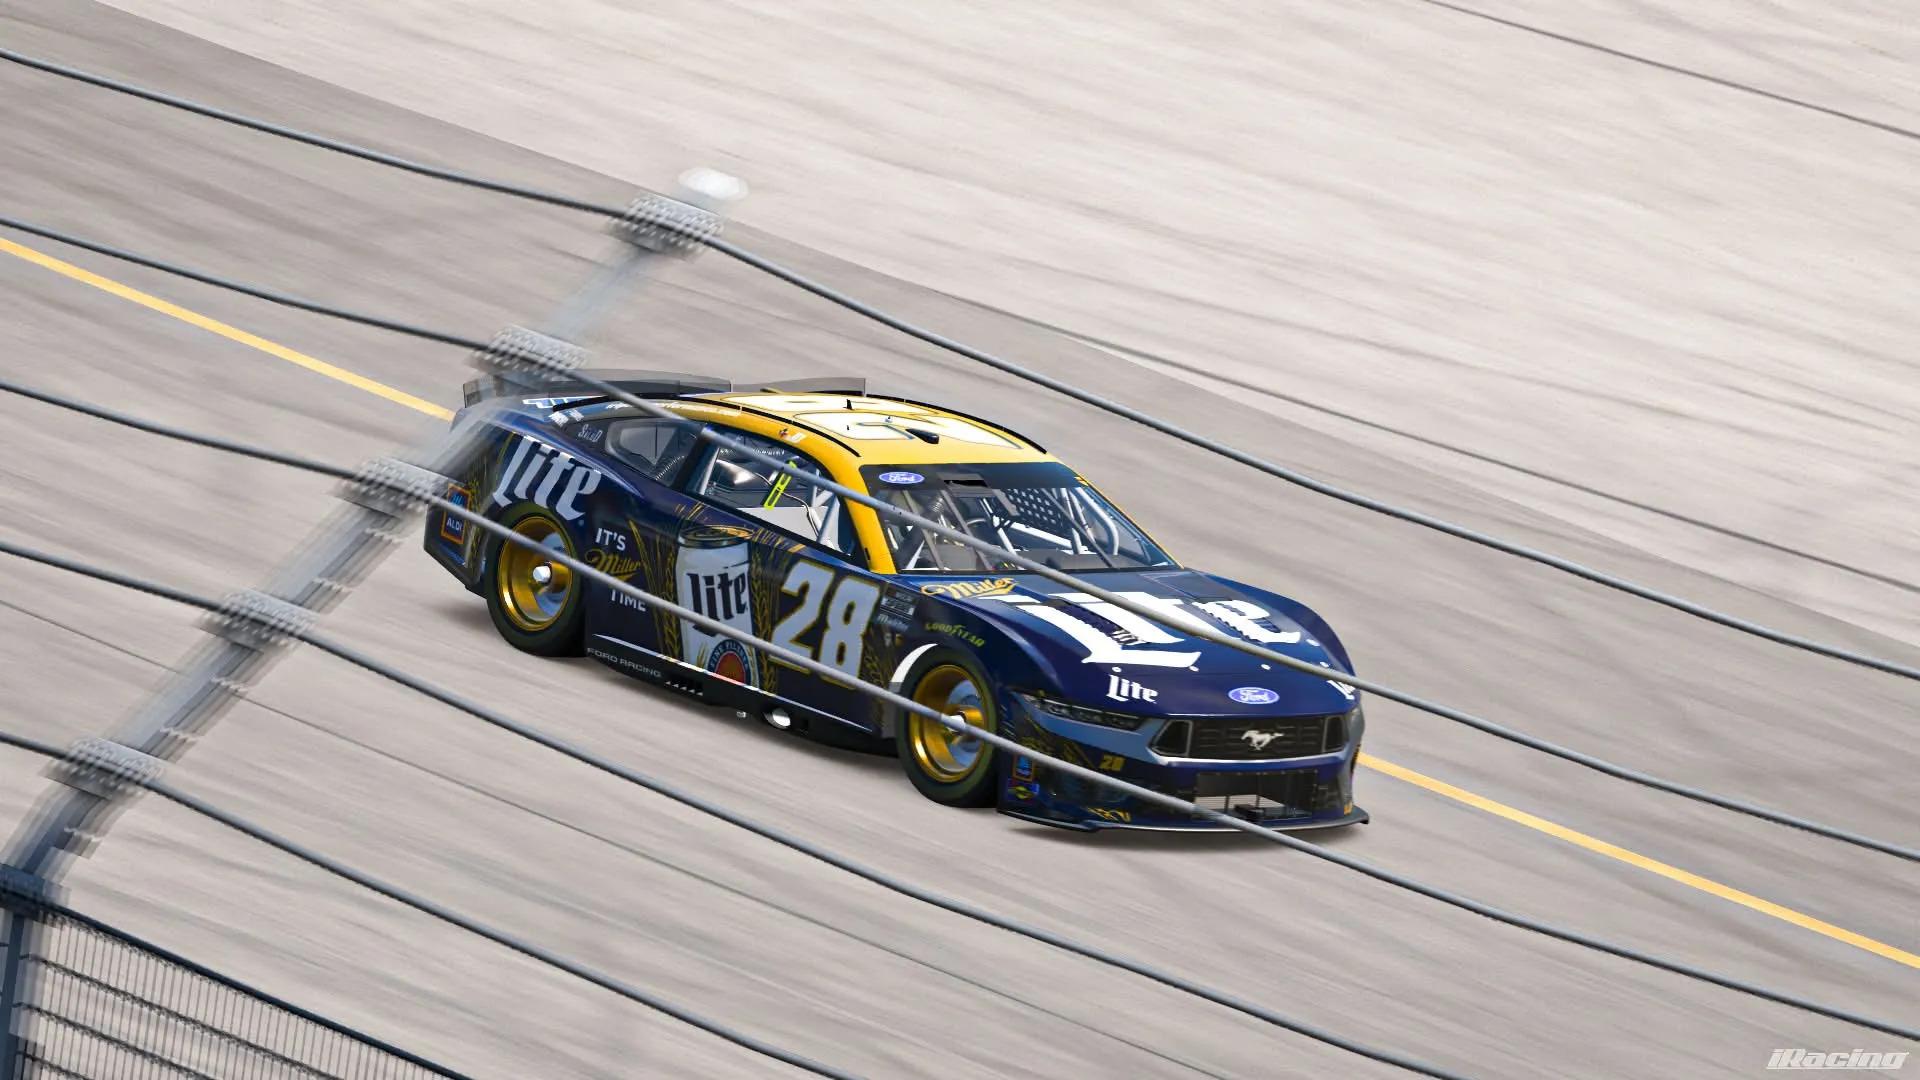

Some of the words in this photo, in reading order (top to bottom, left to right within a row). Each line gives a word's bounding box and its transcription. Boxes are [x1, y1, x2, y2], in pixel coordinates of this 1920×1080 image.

[595, 527, 627, 551] IT'S
[585, 549, 642, 579] Miller
[920, 577, 1018, 600] Miller
[769, 559, 880, 691] 28
[925, 621, 986, 648] GOODYEAR
[587, 647, 618, 663] FORD
[619, 658, 662, 678] RACING
[1106, 674, 1158, 703] Lite
